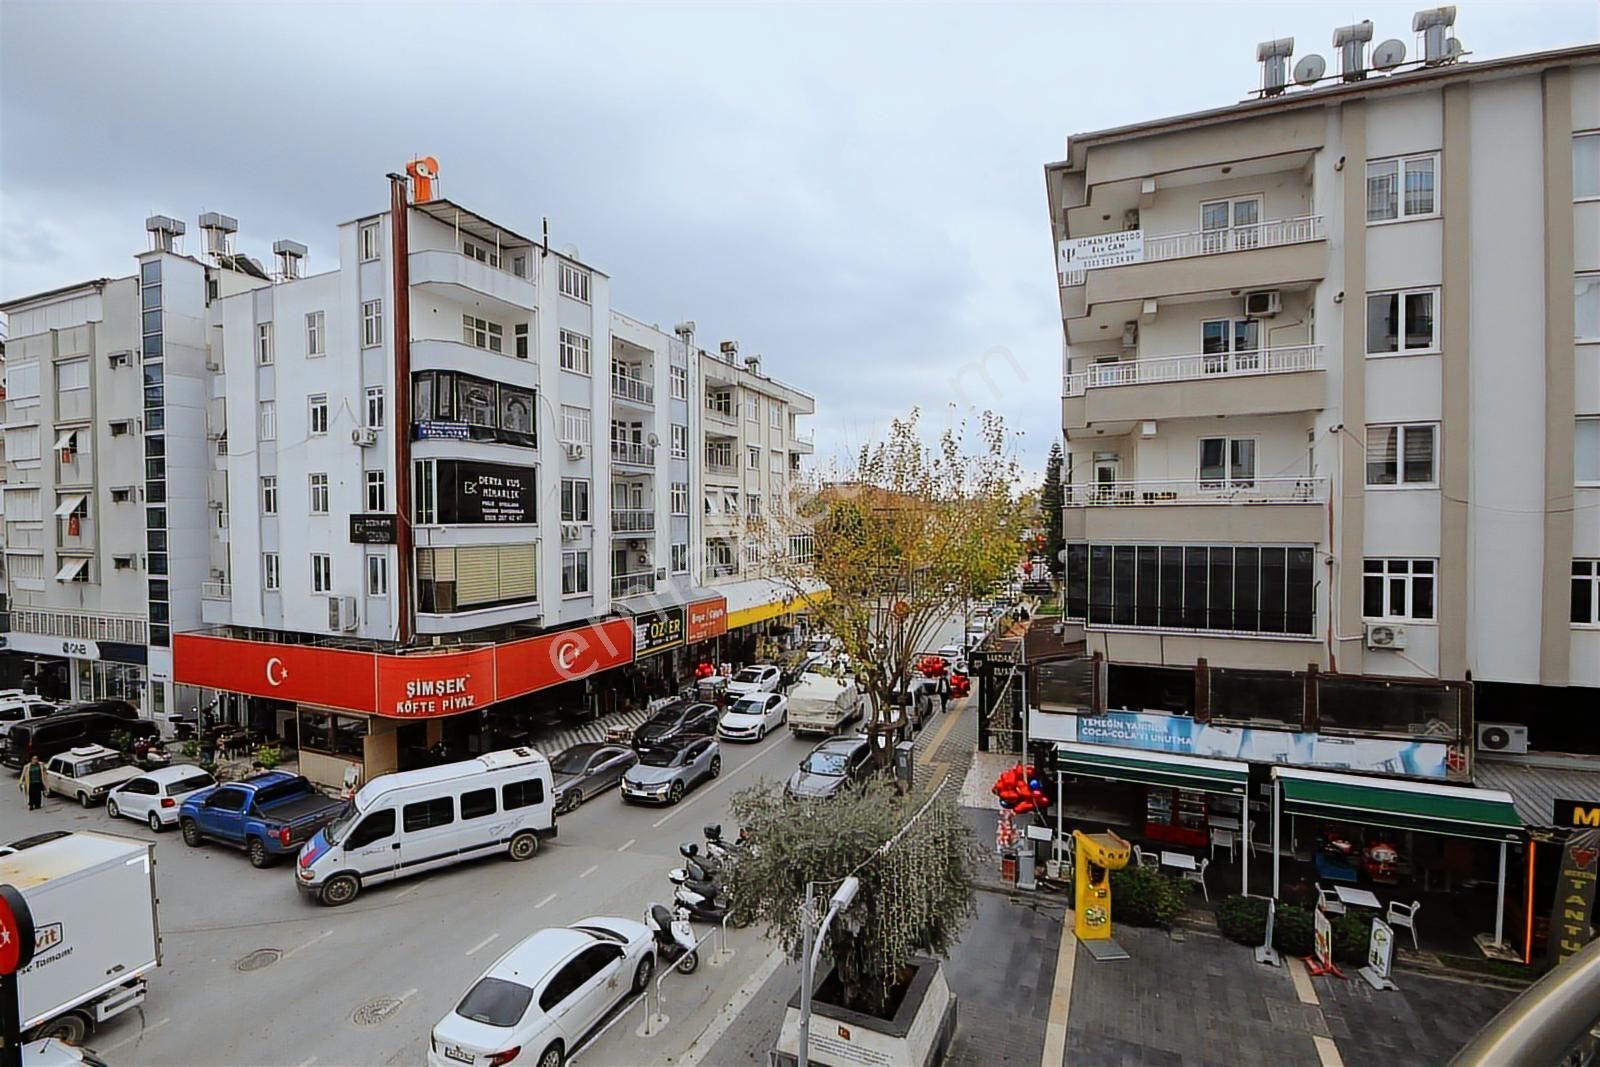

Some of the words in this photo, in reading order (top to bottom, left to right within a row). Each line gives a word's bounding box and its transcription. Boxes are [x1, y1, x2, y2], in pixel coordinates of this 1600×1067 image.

[406, 677, 467, 698] ŞİMŞEK
[396, 700, 436, 713] KÖFTE
[442, 695, 475, 711] PİYAZ
[1151, 734, 1193, 745] UNUTMA
[1559, 879, 1587, 965] TANTU
